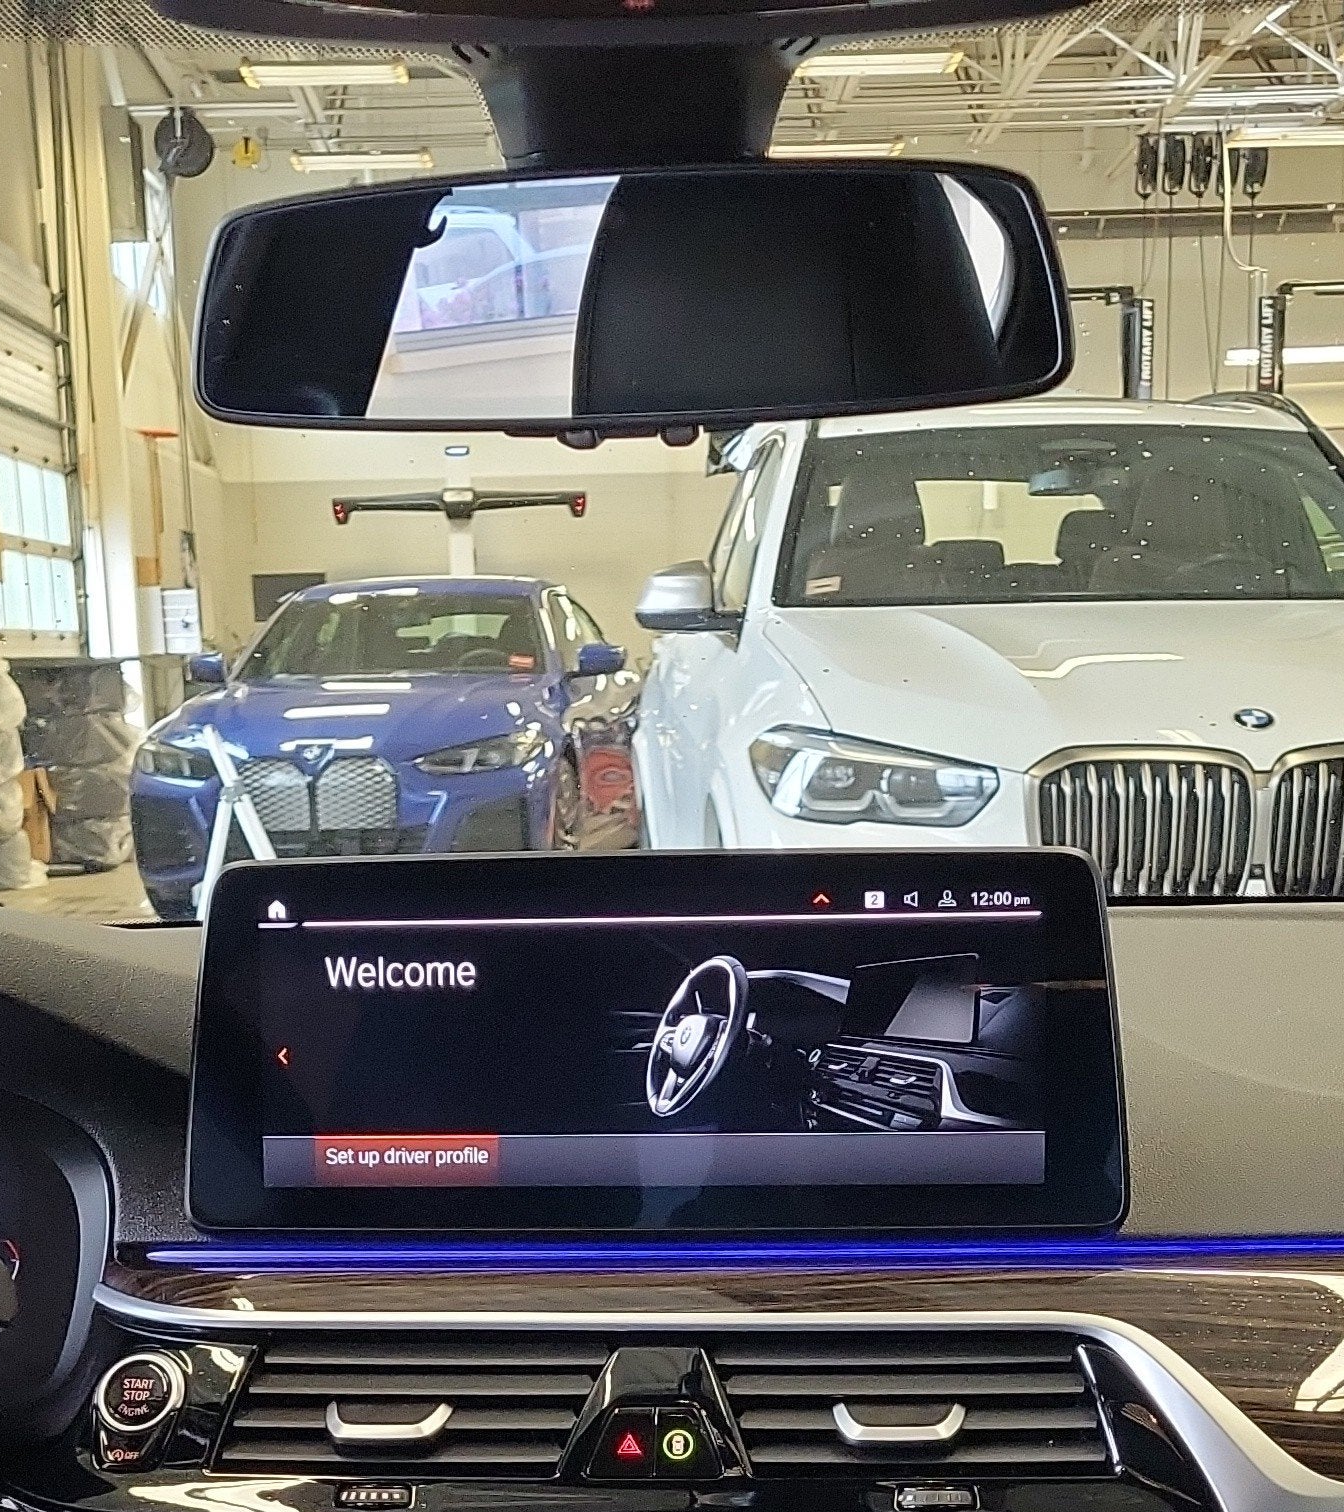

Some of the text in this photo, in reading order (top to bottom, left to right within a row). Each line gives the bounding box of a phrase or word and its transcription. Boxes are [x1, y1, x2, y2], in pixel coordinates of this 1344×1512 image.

[1141, 328, 1153, 380] ROTARY
[1260, 327, 1274, 378] ROTARY
[324, 956, 477, 988] Welcome
[325, 1146, 489, 1168] Set up driver profile
[122, 1378, 156, 1390] START
[122, 1390, 151, 1401] STOP
[117, 1403, 150, 1417] ENGINE
[124, 1451, 140, 1460] OFF
